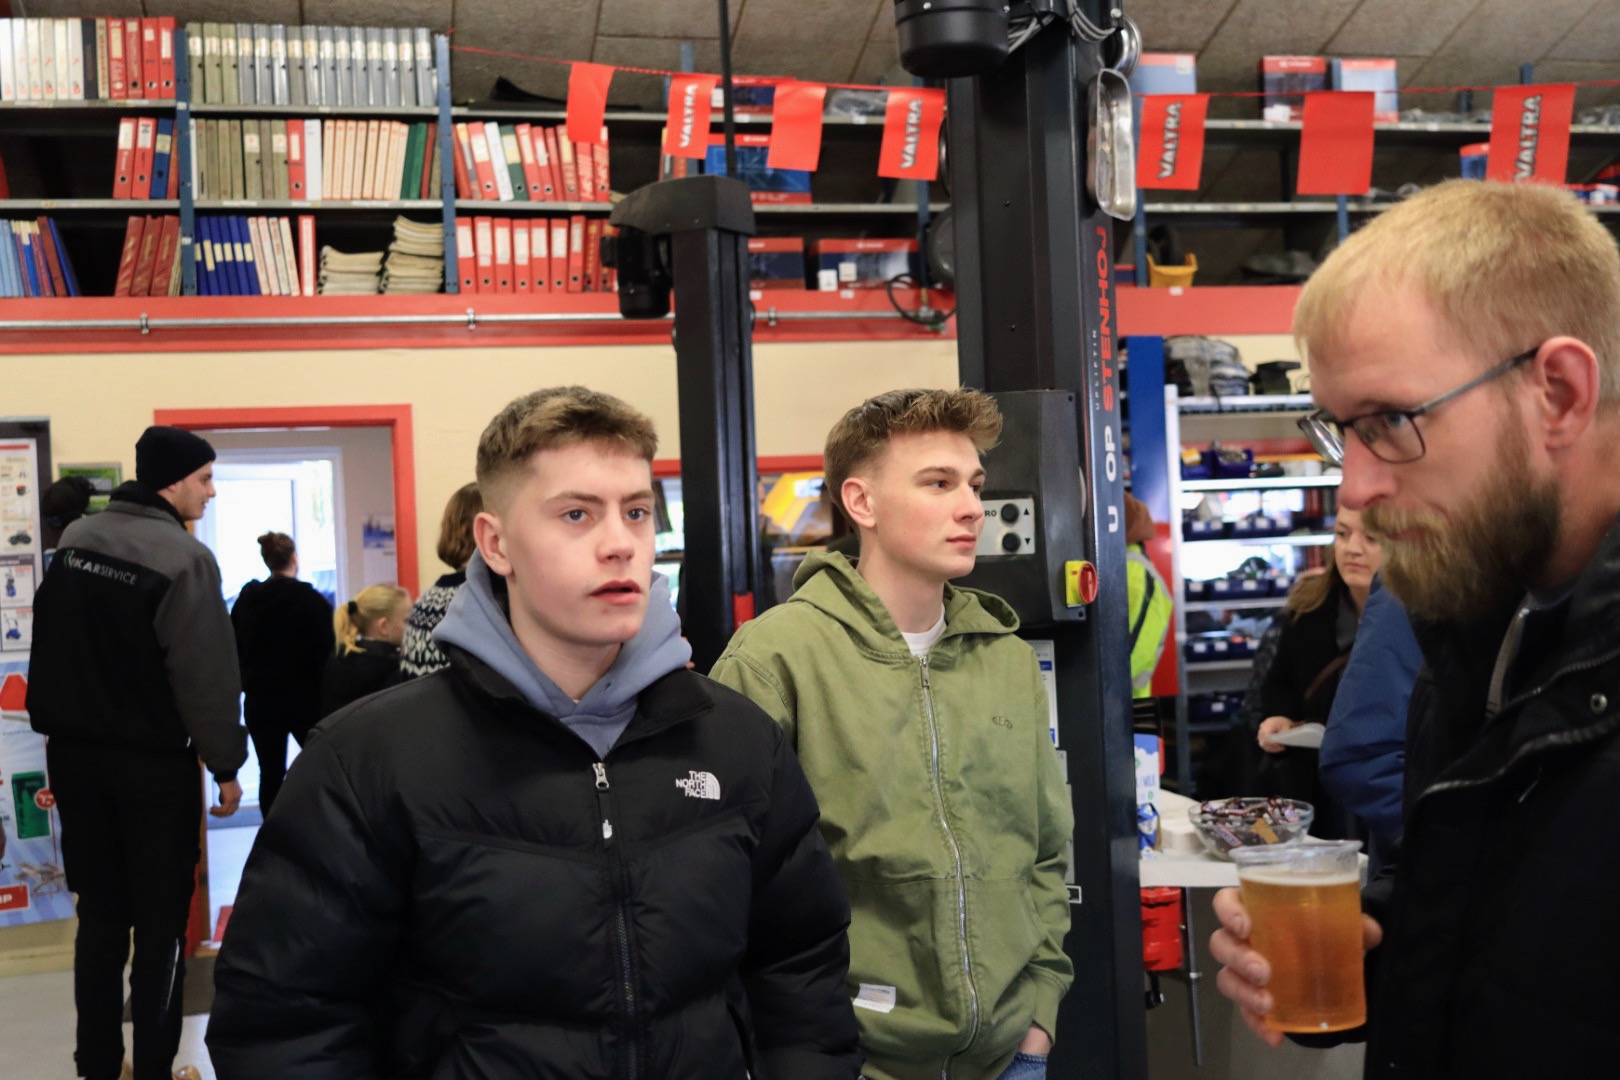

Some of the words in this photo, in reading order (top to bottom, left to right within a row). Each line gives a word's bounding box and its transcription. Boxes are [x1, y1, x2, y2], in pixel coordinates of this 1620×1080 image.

[679, 83, 699, 148] VALTRA
[900, 98, 923, 170] VALTRA
[1157, 102, 1183, 179] VALTRA
[1512, 94, 1543, 180] VALTRA
[675, 778, 706, 789] NORTH
[685, 788, 706, 798] FACE
[689, 770, 706, 780] THE
